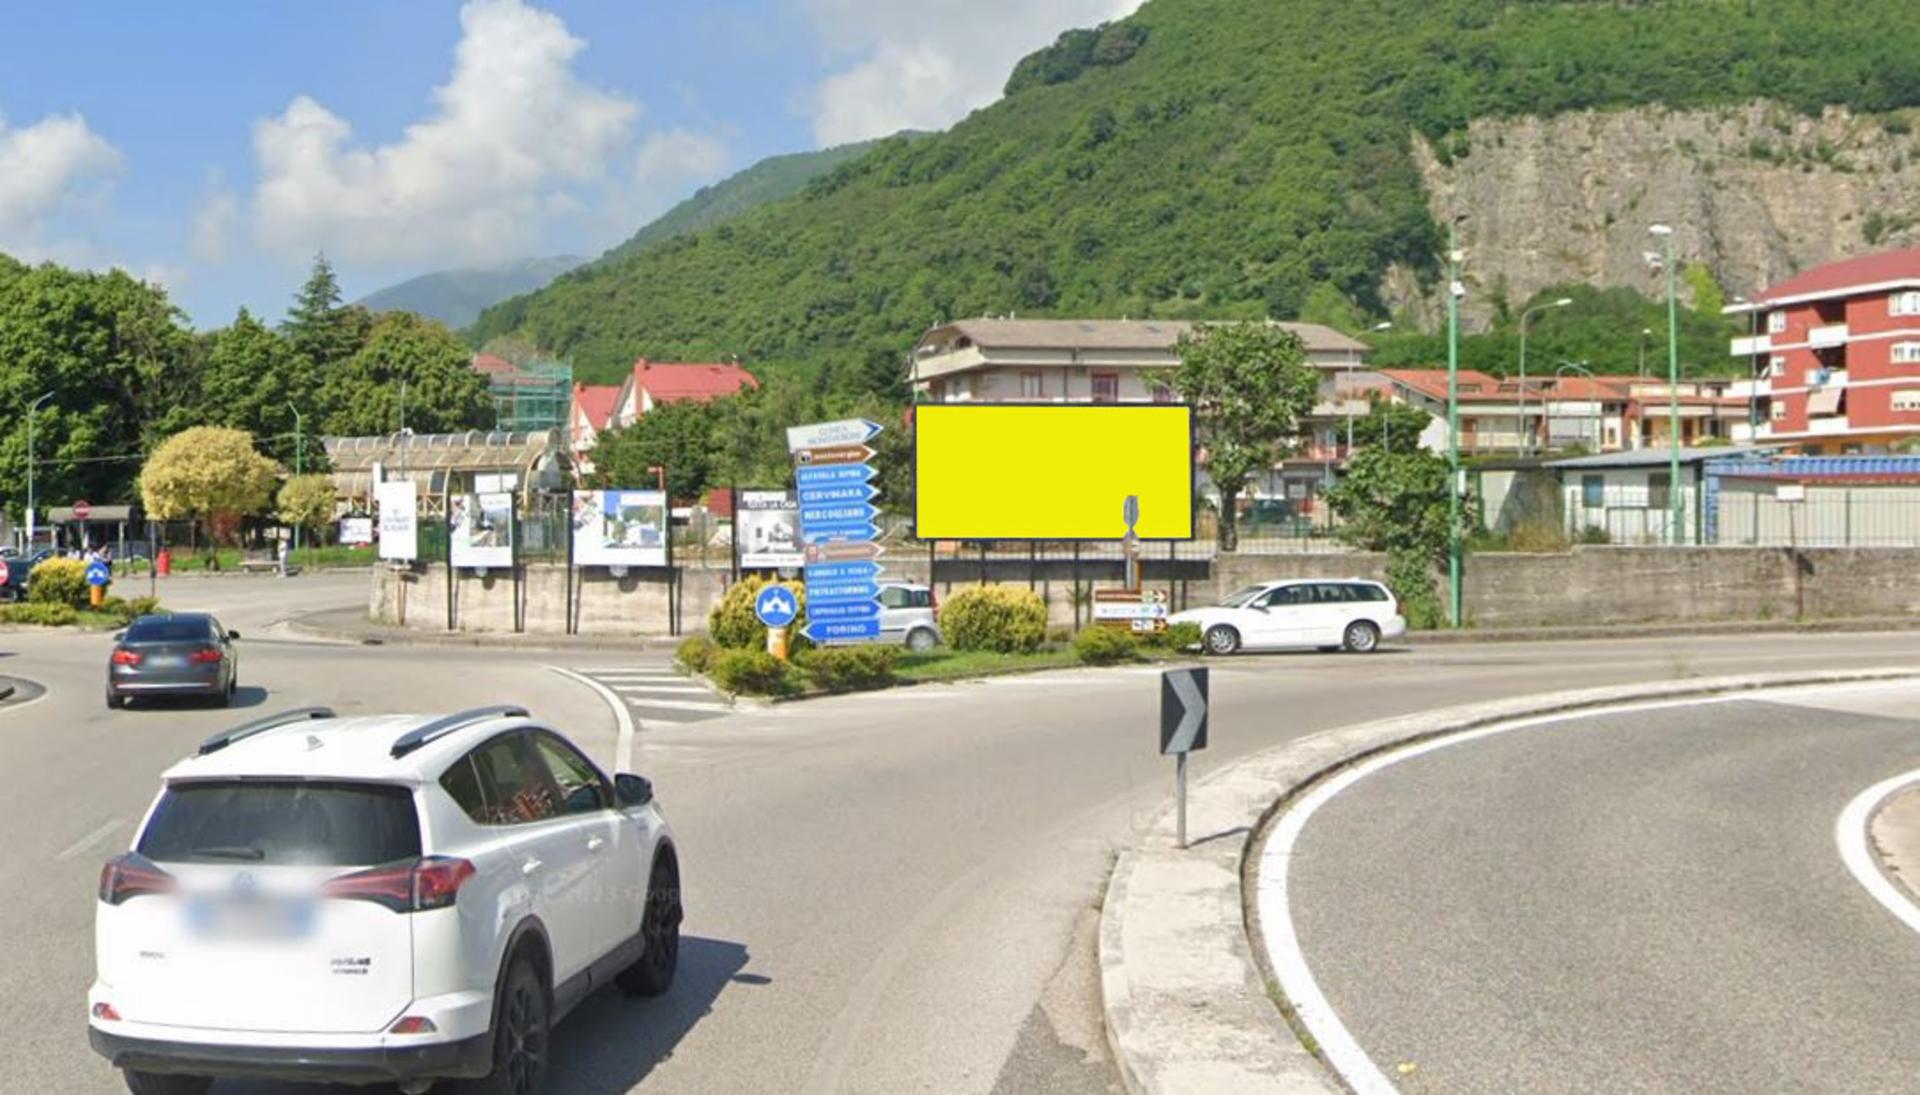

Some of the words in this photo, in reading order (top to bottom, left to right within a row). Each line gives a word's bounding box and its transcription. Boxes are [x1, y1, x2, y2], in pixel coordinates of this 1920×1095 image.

[802, 488, 862, 501] CERVINARA
[804, 507, 865, 520] MERCOGLIANO
[826, 624, 867, 635] FORINO
